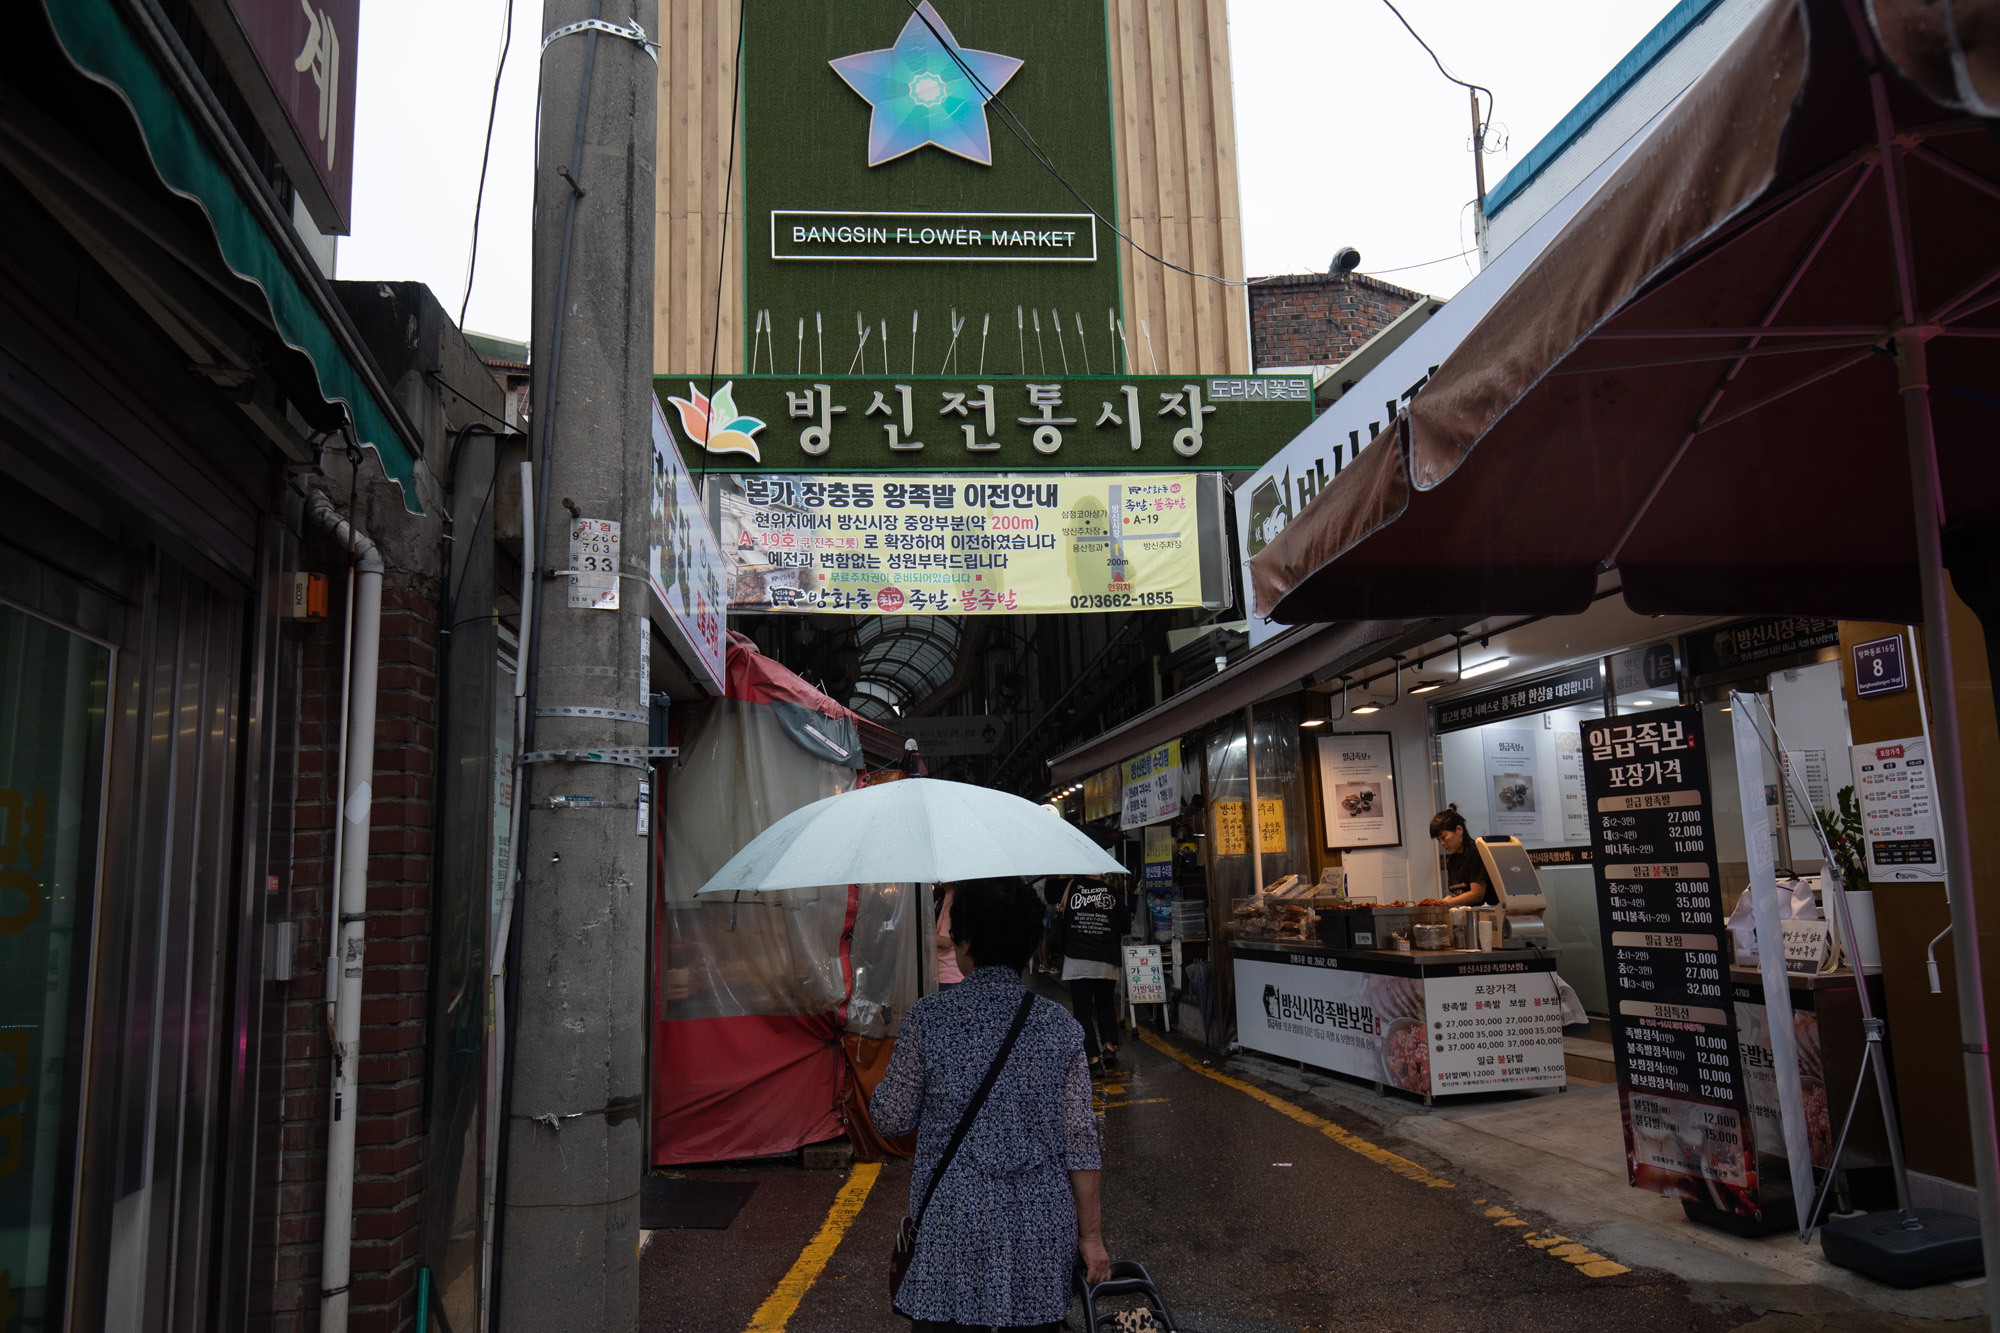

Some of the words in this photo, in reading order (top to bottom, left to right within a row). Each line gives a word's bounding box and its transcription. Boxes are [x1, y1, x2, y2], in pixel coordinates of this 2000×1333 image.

[793, 227, 886, 243] BANGSIN
[897, 228, 981, 245] FLOWER
[991, 230, 1076, 247] MARKET
[1210, 379, 1308, 399] 도라지꽃문
[786, 383, 1217, 458] 방신전통시장
[745, 480, 795, 506] 본가
[801, 482, 874, 508] 장충동
[883, 483, 956, 509] 왕족발
[963, 483, 1059, 509] 이전안내
[755, 512, 832, 530] 현위치에서
[837, 514, 898, 531] 방신시장
[904, 514, 986, 532] 중앙부분(약
[991, 514, 1040, 531] 200m)
[1111, 504, 1120, 539] 방신시장
[1133, 514, 1159, 525] A-19
[1062, 527, 1101, 537] 방신주차장
[814, 536, 860, 549] 진주그릇)
[864, 534, 878, 550] 로
[884, 534, 945, 550] 확장하여
[951, 533, 1056, 550] 이전하였습니다
[1072, 543, 1104, 553] 용산청과
[1143, 540, 1182, 551] 방신주차장
[768, 551, 815, 569] 예전과
[820, 552, 882, 569] 변함없는
[887, 553, 1009, 570] 성원부탁드립니다
[1106, 558, 1129, 567] 200m
[829, 572, 890, 584] 무료주차권이
[893, 572, 971, 584] 준비되어있습니다
[1107, 582, 1131, 592] 현위치
[808, 588, 873, 609] 방화동
[1070, 591, 1174, 610] 02)3662-1855
[1872, 658, 1884, 677] 8
[1441, 709, 1459, 724] 최고의
[1460, 707, 1473, 720] 맛과
[1473, 700, 1500, 717] 서비스로
[1528, 685, 1553, 706] 한상을
[1555, 676, 1594, 698] 대접합니다
[1589, 720, 1689, 762] 일급족보
[1609, 758, 1683, 788] 포장가격
[1625, 796, 1642, 808] 일급
[1644, 793, 1671, 807] 왕족발
[1602, 816, 1636, 828] 중(2~3인)
[1667, 810, 1701, 824] 27,000
[1603, 830, 1638, 841] 대(3~4인)
[1669, 825, 1703, 838] 32,000
[1675, 840, 1704, 853] 11,000
[1633, 865, 1650, 877] 일급
[1652, 864, 1679, 877] 불족발
[1080, 887, 1108, 895] DELICIOUS
[1609, 882, 1643, 894] 중(2~3인)
[1675, 881, 1709, 894] 30,000
[1070, 892, 1102, 910] Bread
[1610, 896, 1646, 908] 대(3~4인)
[1676, 896, 1711, 909] 35,000
[1680, 911, 1712, 924] 12,000
[1645, 934, 1661, 947] 일급
[1664, 935, 1683, 948] 보쌈
[1616, 948, 1649, 961] 소(1~2인)
[1684, 952, 1718, 965] 15,000
[1458, 962, 1524, 974] 방신시장족발보쌈
[1618, 962, 1653, 976] 중(2~3인)
[1685, 967, 1719, 980] 27,000
[1474, 983, 1517, 995] 포장가격
[1619, 976, 1655, 990] 대(3~4인)
[1687, 983, 1721, 997] 32,000
[1441, 1002, 1468, 1012] 왕족발
[1475, 1000, 1501, 1010] 불족발
[1509, 998, 1527, 1008] 보쌈
[1533, 996, 1559, 1007] 불보쌈
[1654, 1004, 1690, 1019] 점심특선
[1281, 993, 1374, 1035] 방신시장족발보쌈
[1446, 1020, 1474, 1029] 27,000
[1475, 1018, 1503, 1027] 30,000
[1505, 1016, 1533, 1025] 27,000
[1534, 1014, 1561, 1023] 30,000
[1447, 1031, 1475, 1041] 32,000
[1476, 1029, 1504, 1039] 35,000
[1506, 1027, 1534, 1037] 32,000
[1535, 1026, 1562, 1035] 35,000
[1625, 1026, 1675, 1043] 족발정식(1인)
[1694, 1035, 1727, 1050] 10,000
[1448, 1043, 1475, 1052] 37,000
[1477, 1041, 1504, 1050] 40,000
[1507, 1039, 1535, 1048] 37,000
[1535, 1037, 1563, 1047] 40,000
[1476, 1056, 1495, 1066] 일급
[1497, 1054, 1524, 1064] 불닭발
[1626, 1041, 1686, 1061] 불족발정식(1인)
[1696, 1051, 1729, 1067] 12,000
[1473, 1070, 1495, 1078] 12000
[1543, 1064, 1565, 1072] 15000
[1629, 1058, 1679, 1076] 보쌈정식(1인)
[1698, 1068, 1731, 1084] 10,000
[1630, 1073, 1689, 1093] 불보쌈정식(1인)
[1700, 1084, 1733, 1100] 12,000
